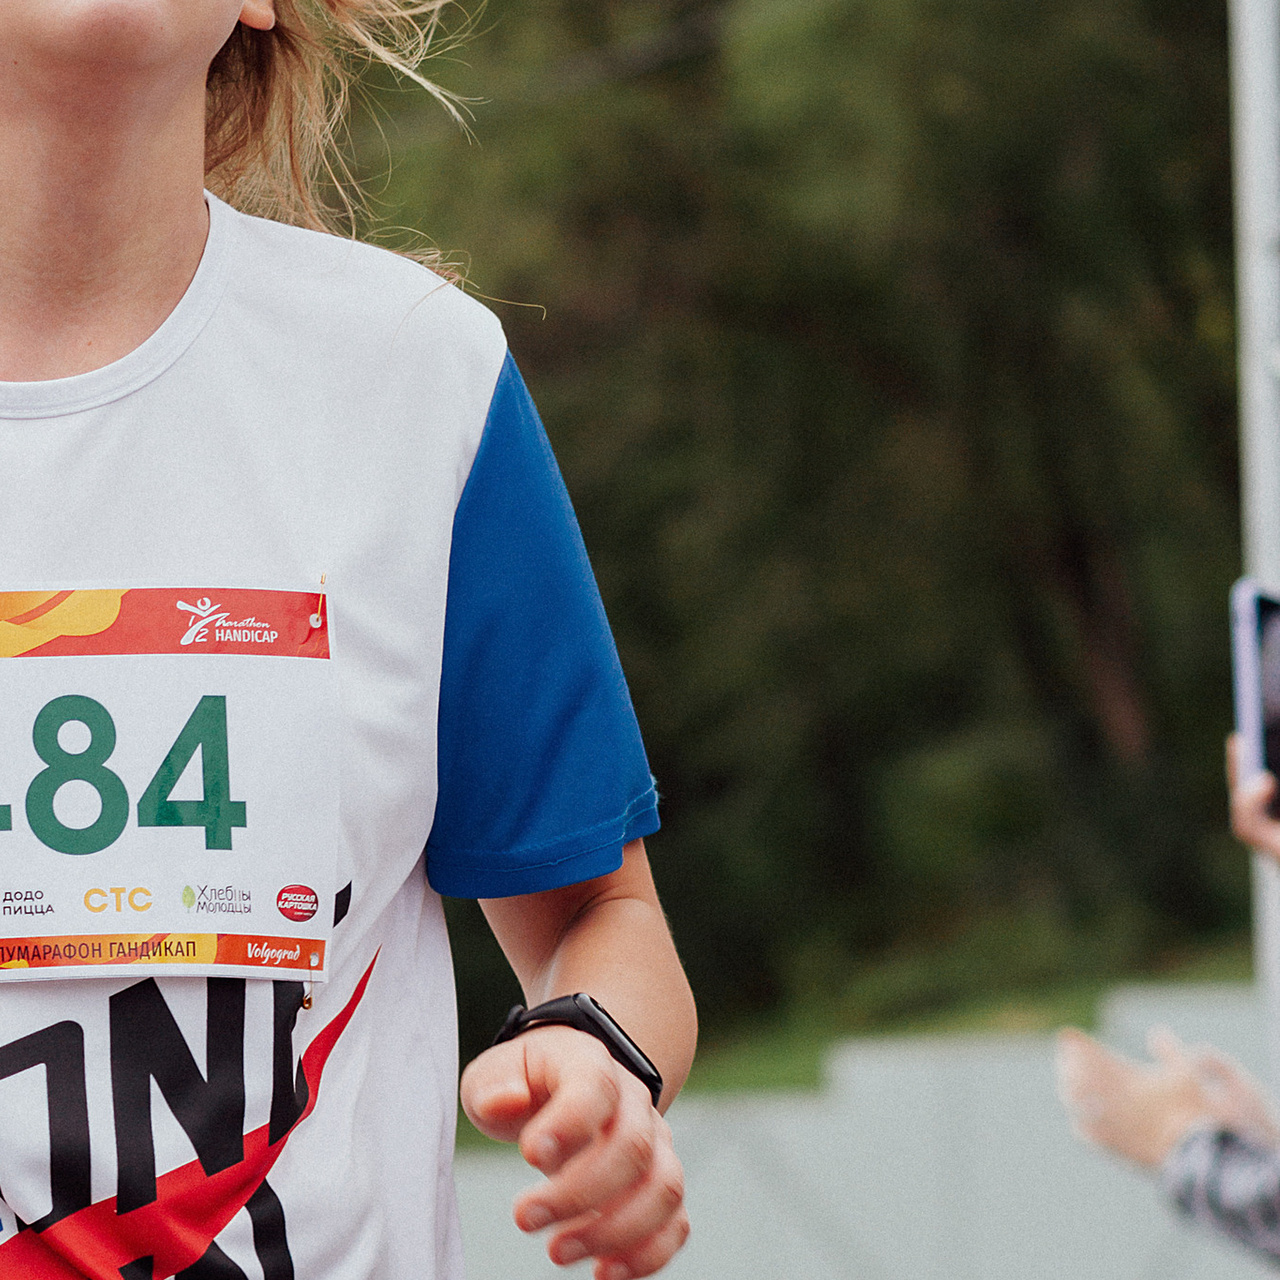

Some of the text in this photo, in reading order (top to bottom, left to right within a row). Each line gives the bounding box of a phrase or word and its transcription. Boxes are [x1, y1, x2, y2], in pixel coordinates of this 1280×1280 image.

[215, 629, 279, 643] HANDICAP
[2, 890, 45, 903] ДОДО
[83, 887, 153, 914] СТС
[281, 893, 316, 902] РУССКАЯ
[3, 905, 55, 917] ПИЦЦА
[277, 900, 318, 910] КАРТОШКА
[109, 940, 197, 961] ГАНДИКАП
[246, 941, 301, 968] Volgograd
